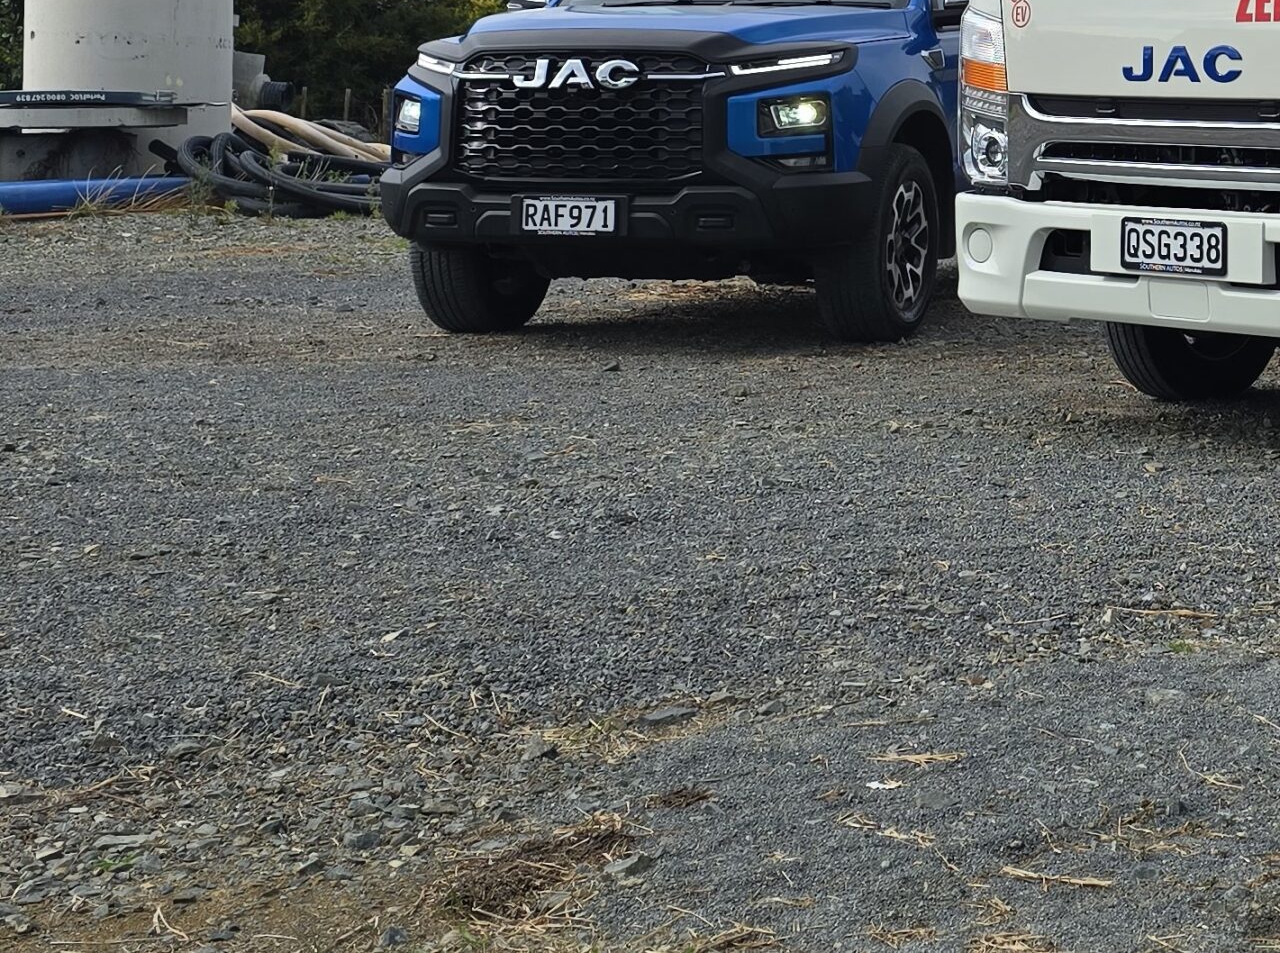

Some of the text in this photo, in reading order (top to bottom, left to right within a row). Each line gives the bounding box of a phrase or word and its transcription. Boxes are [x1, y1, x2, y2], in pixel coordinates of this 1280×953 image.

[1015, 5, 1028, 23] EV
[512, 59, 640, 89] JAC
[1122, 44, 1243, 83] JAC
[524, 203, 609, 229] RAF971
[1127, 228, 1220, 264] QSG338
[1139, 263, 1166, 271] SOUTHERN
[1166, 265, 1183, 273] AUTOS
